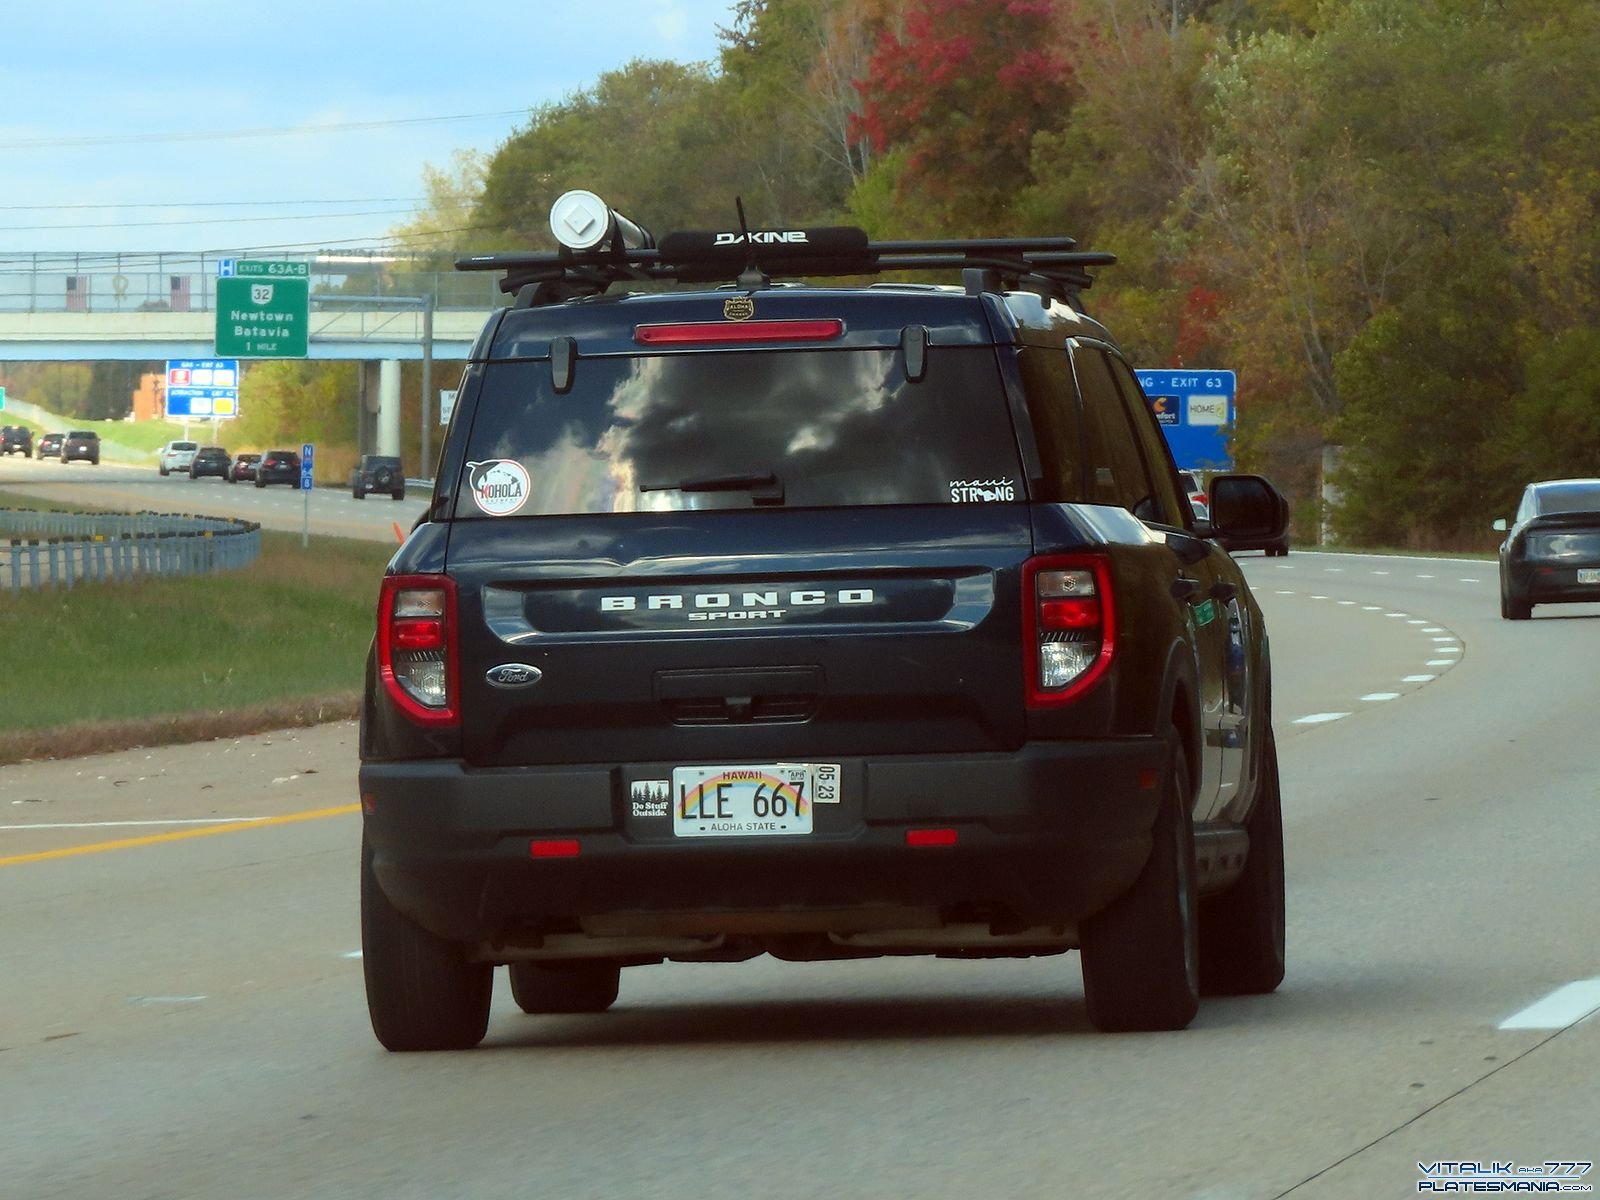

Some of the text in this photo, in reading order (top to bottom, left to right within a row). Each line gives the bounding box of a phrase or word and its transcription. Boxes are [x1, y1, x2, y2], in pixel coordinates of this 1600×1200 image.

[238, 263, 307, 275] EXITS 63A-B
[253, 288, 270, 300] 32
[230, 310, 294, 321] Newtown
[234, 325, 290, 337] Batavia
[256, 343, 278, 351] MILE
[1171, 377, 1199, 388] EXIT
[1205, 378, 1222, 388] 63
[949, 476, 1014, 487] maui
[481, 483, 522, 499] KOHOLA
[601, 589, 873, 611] BRONCO
[688, 609, 787, 621] SPORT
[722, 771, 763, 781] HAWAII
[632, 801, 668, 810] Do Stuff
[680, 781, 806, 820] LLE 667
[632, 809, 667, 817] Outside.
[710, 822, 776, 831] ALOHA STATE
